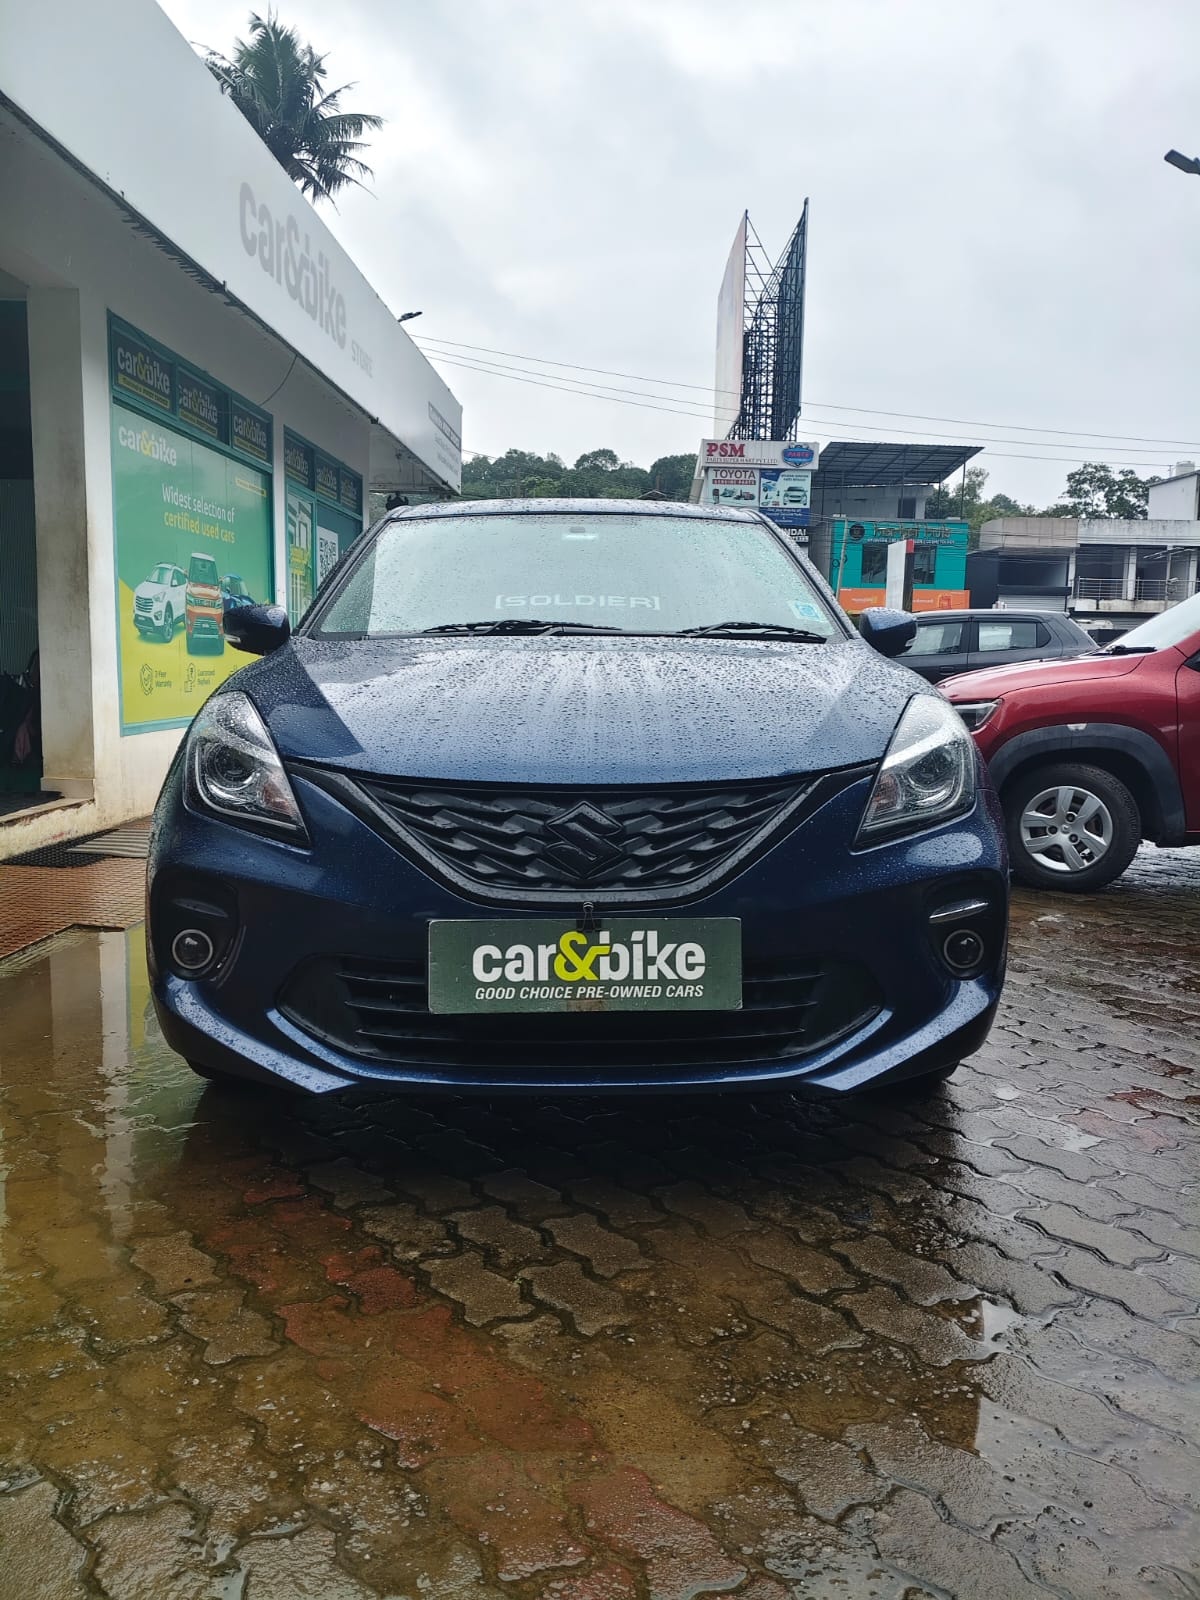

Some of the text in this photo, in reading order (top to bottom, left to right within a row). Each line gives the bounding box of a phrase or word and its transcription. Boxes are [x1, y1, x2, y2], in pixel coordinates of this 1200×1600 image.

[240, 181, 346, 349] car&bike
[117, 347, 170, 394] car&bike
[119, 426, 177, 466] car&bike
[233, 415, 267, 448] car&bike
[706, 443, 746, 457] PSM
[713, 469, 756, 479] TOYOTA
[162, 484, 236, 523] Widest selection of
[164, 511, 236, 543] certified used cars
[472, 930, 706, 982] car&bike
[475, 984, 705, 1000] GOOD CHOICE PRE-OWNED CARS
